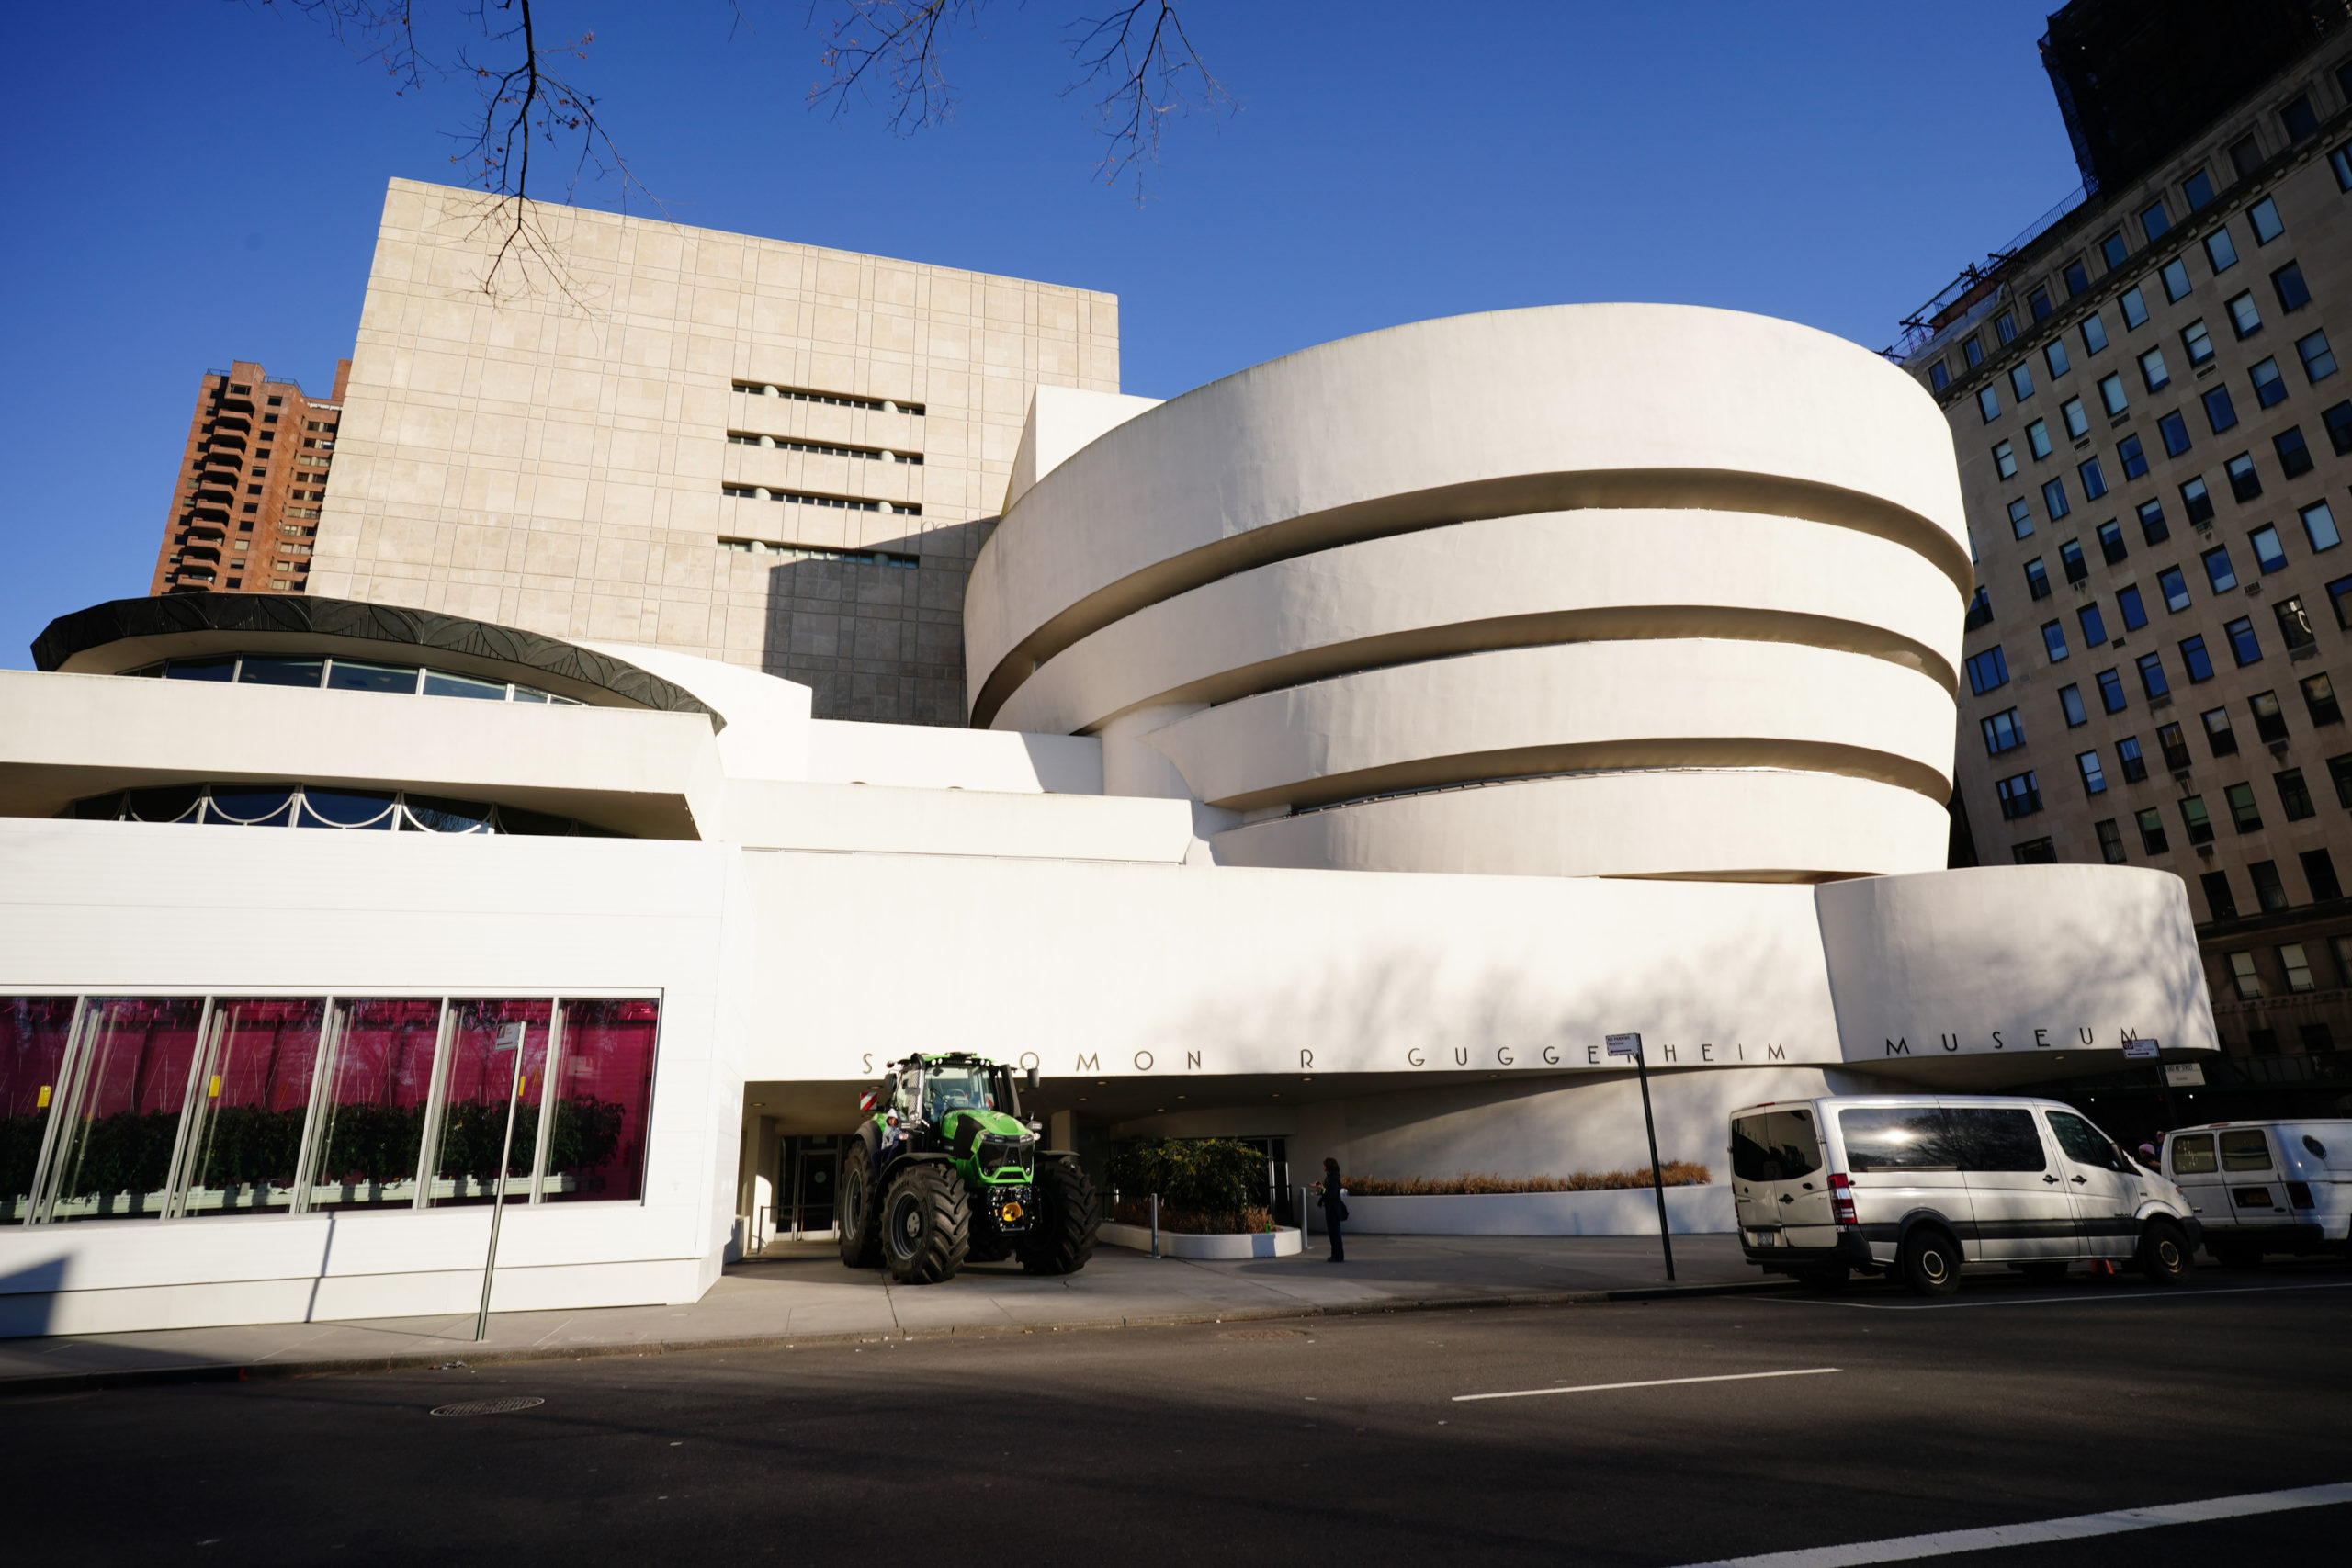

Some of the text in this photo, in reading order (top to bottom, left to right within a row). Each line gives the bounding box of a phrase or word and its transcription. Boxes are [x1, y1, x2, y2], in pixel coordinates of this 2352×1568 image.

[1885, 1026, 2139, 1056] MUSEUM
[862, 1043, 1786, 1075] SOMON R GUGGEHEIM
